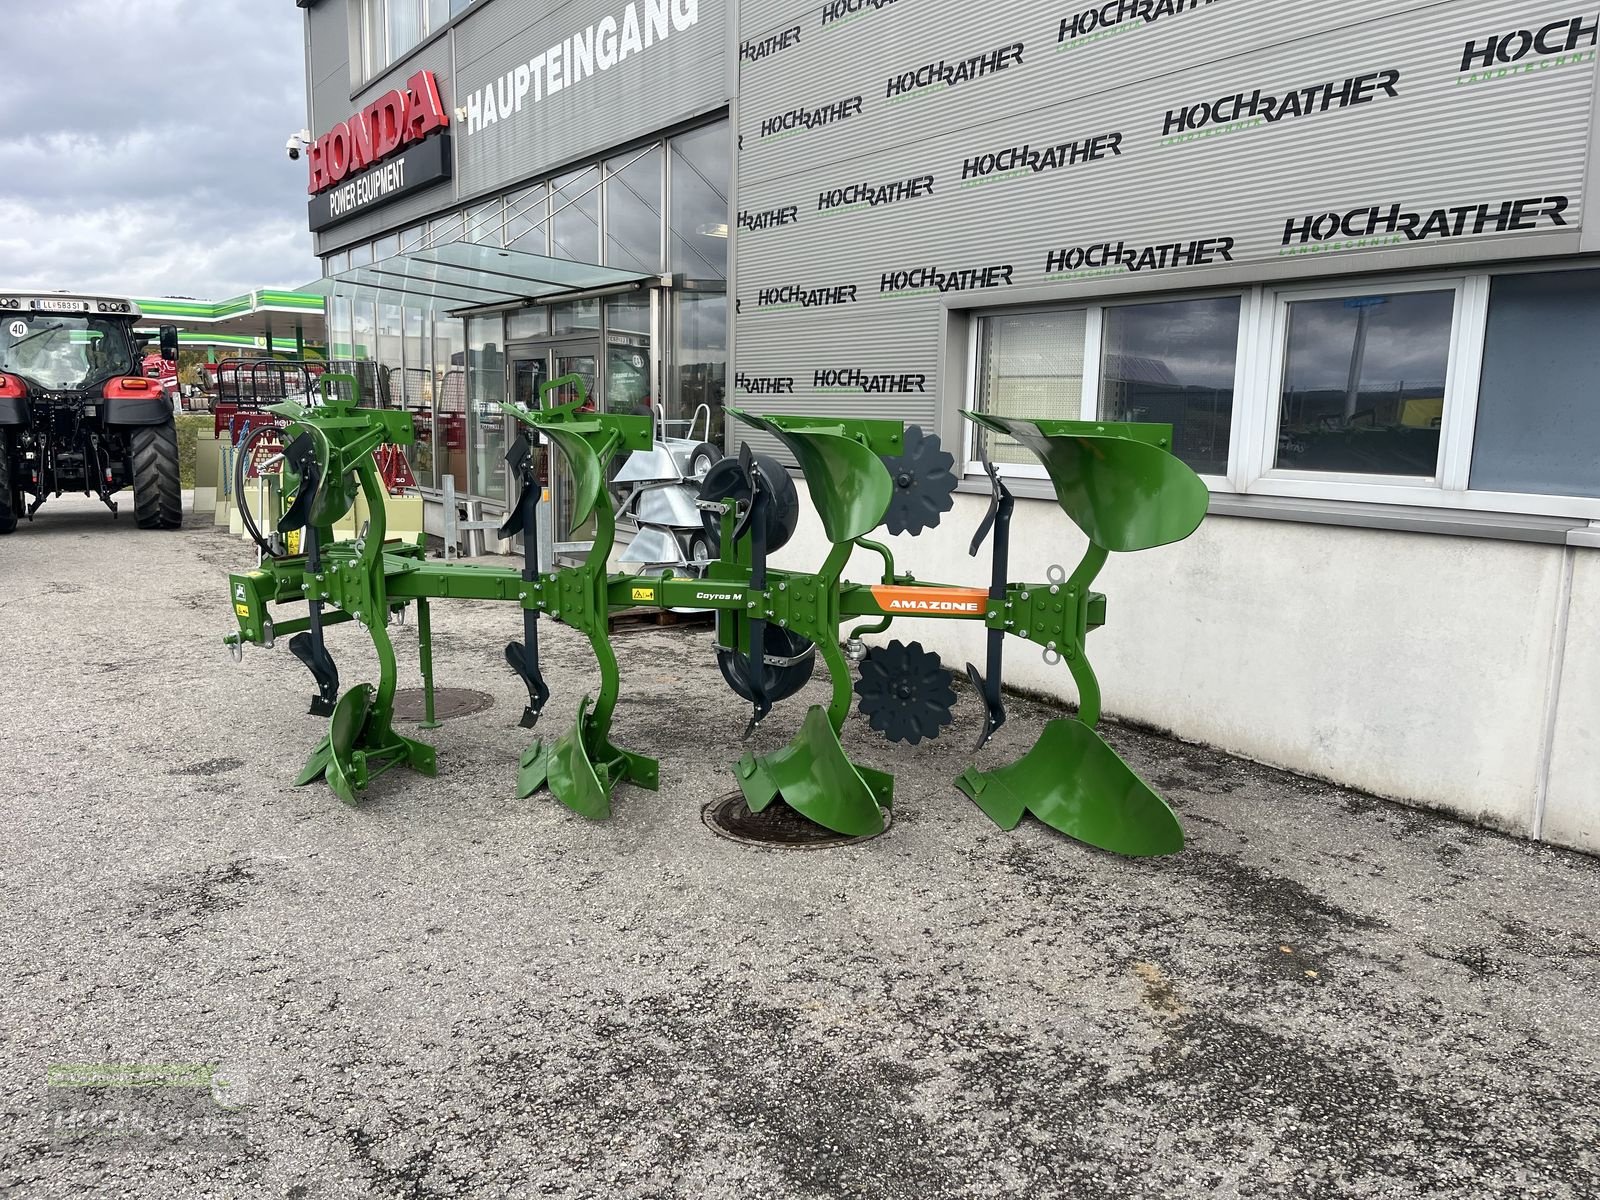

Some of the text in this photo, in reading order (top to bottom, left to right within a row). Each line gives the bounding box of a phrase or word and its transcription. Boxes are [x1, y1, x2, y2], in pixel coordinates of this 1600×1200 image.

[467, 0, 698, 136] HAUPTEINGANG
[886, 42, 1025, 98] HOCHRATHER
[760, 95, 863, 138] HOCHRATHER
[1161, 69, 1400, 136] HOCHRATHER
[306, 69, 450, 196] HONDA
[1159, 117, 1263, 147] LANDTECHNIK
[961, 132, 1123, 180] HOCHRATHER
[329, 158, 406, 218] POWER EQUIPMENT
[817, 175, 935, 211] HOCHRATHER
[1281, 196, 1569, 246] HOCHRATHER
[1045, 236, 1235, 273] HOCHRATHER
[1278, 235, 1402, 256] LANDTECHNIK
[758, 284, 857, 308] HOCHRATHER
[880, 264, 1014, 293] HOCHRATHER
[12, 324, 24, 335] 40
[813, 368, 926, 393] HOCHRATHER
[696, 592, 743, 601] Cayros M
[889, 599, 979, 612] AMAZONE
